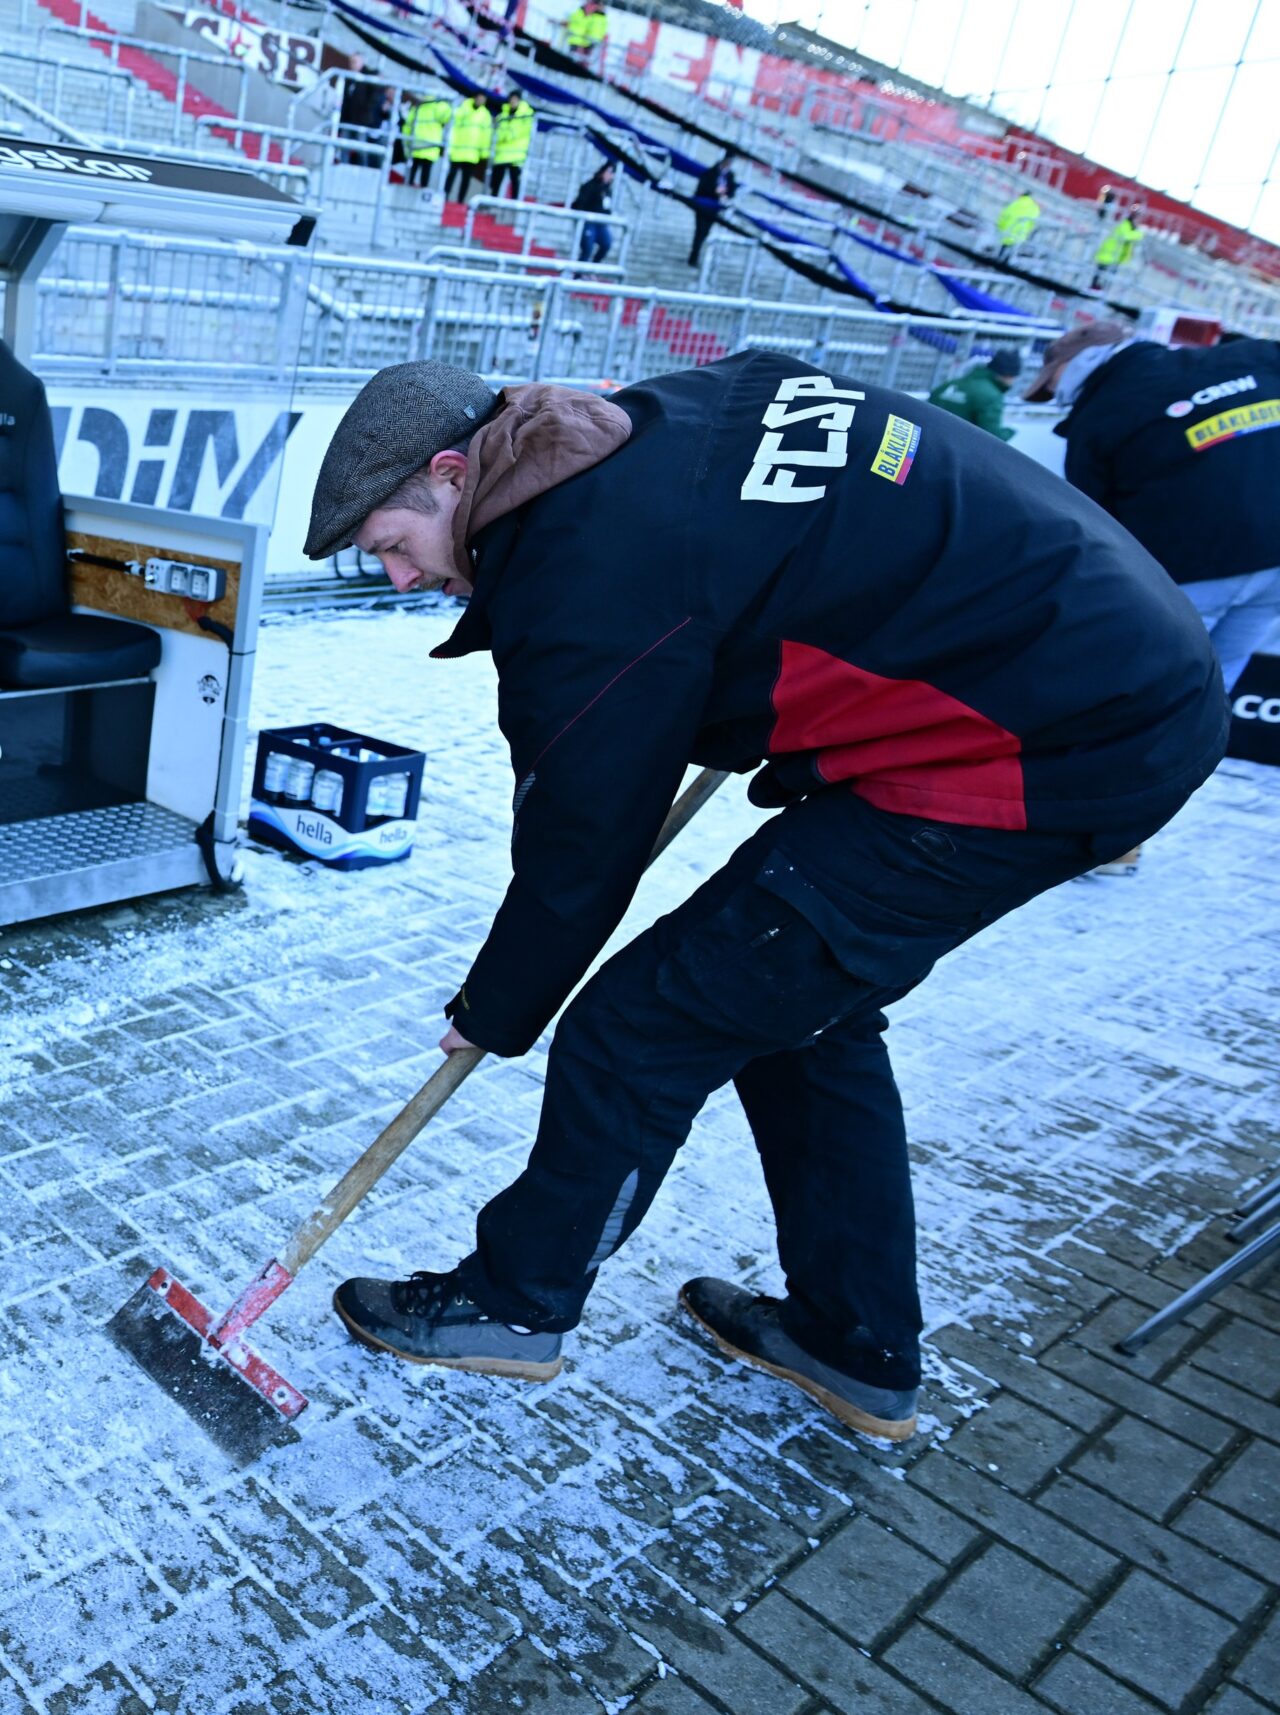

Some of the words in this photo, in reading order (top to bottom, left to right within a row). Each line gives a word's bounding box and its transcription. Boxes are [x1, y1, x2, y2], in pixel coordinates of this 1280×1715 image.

[740, 376, 865, 503] FCSP
[296, 814, 333, 845] hella
[379, 827, 407, 845] hella
